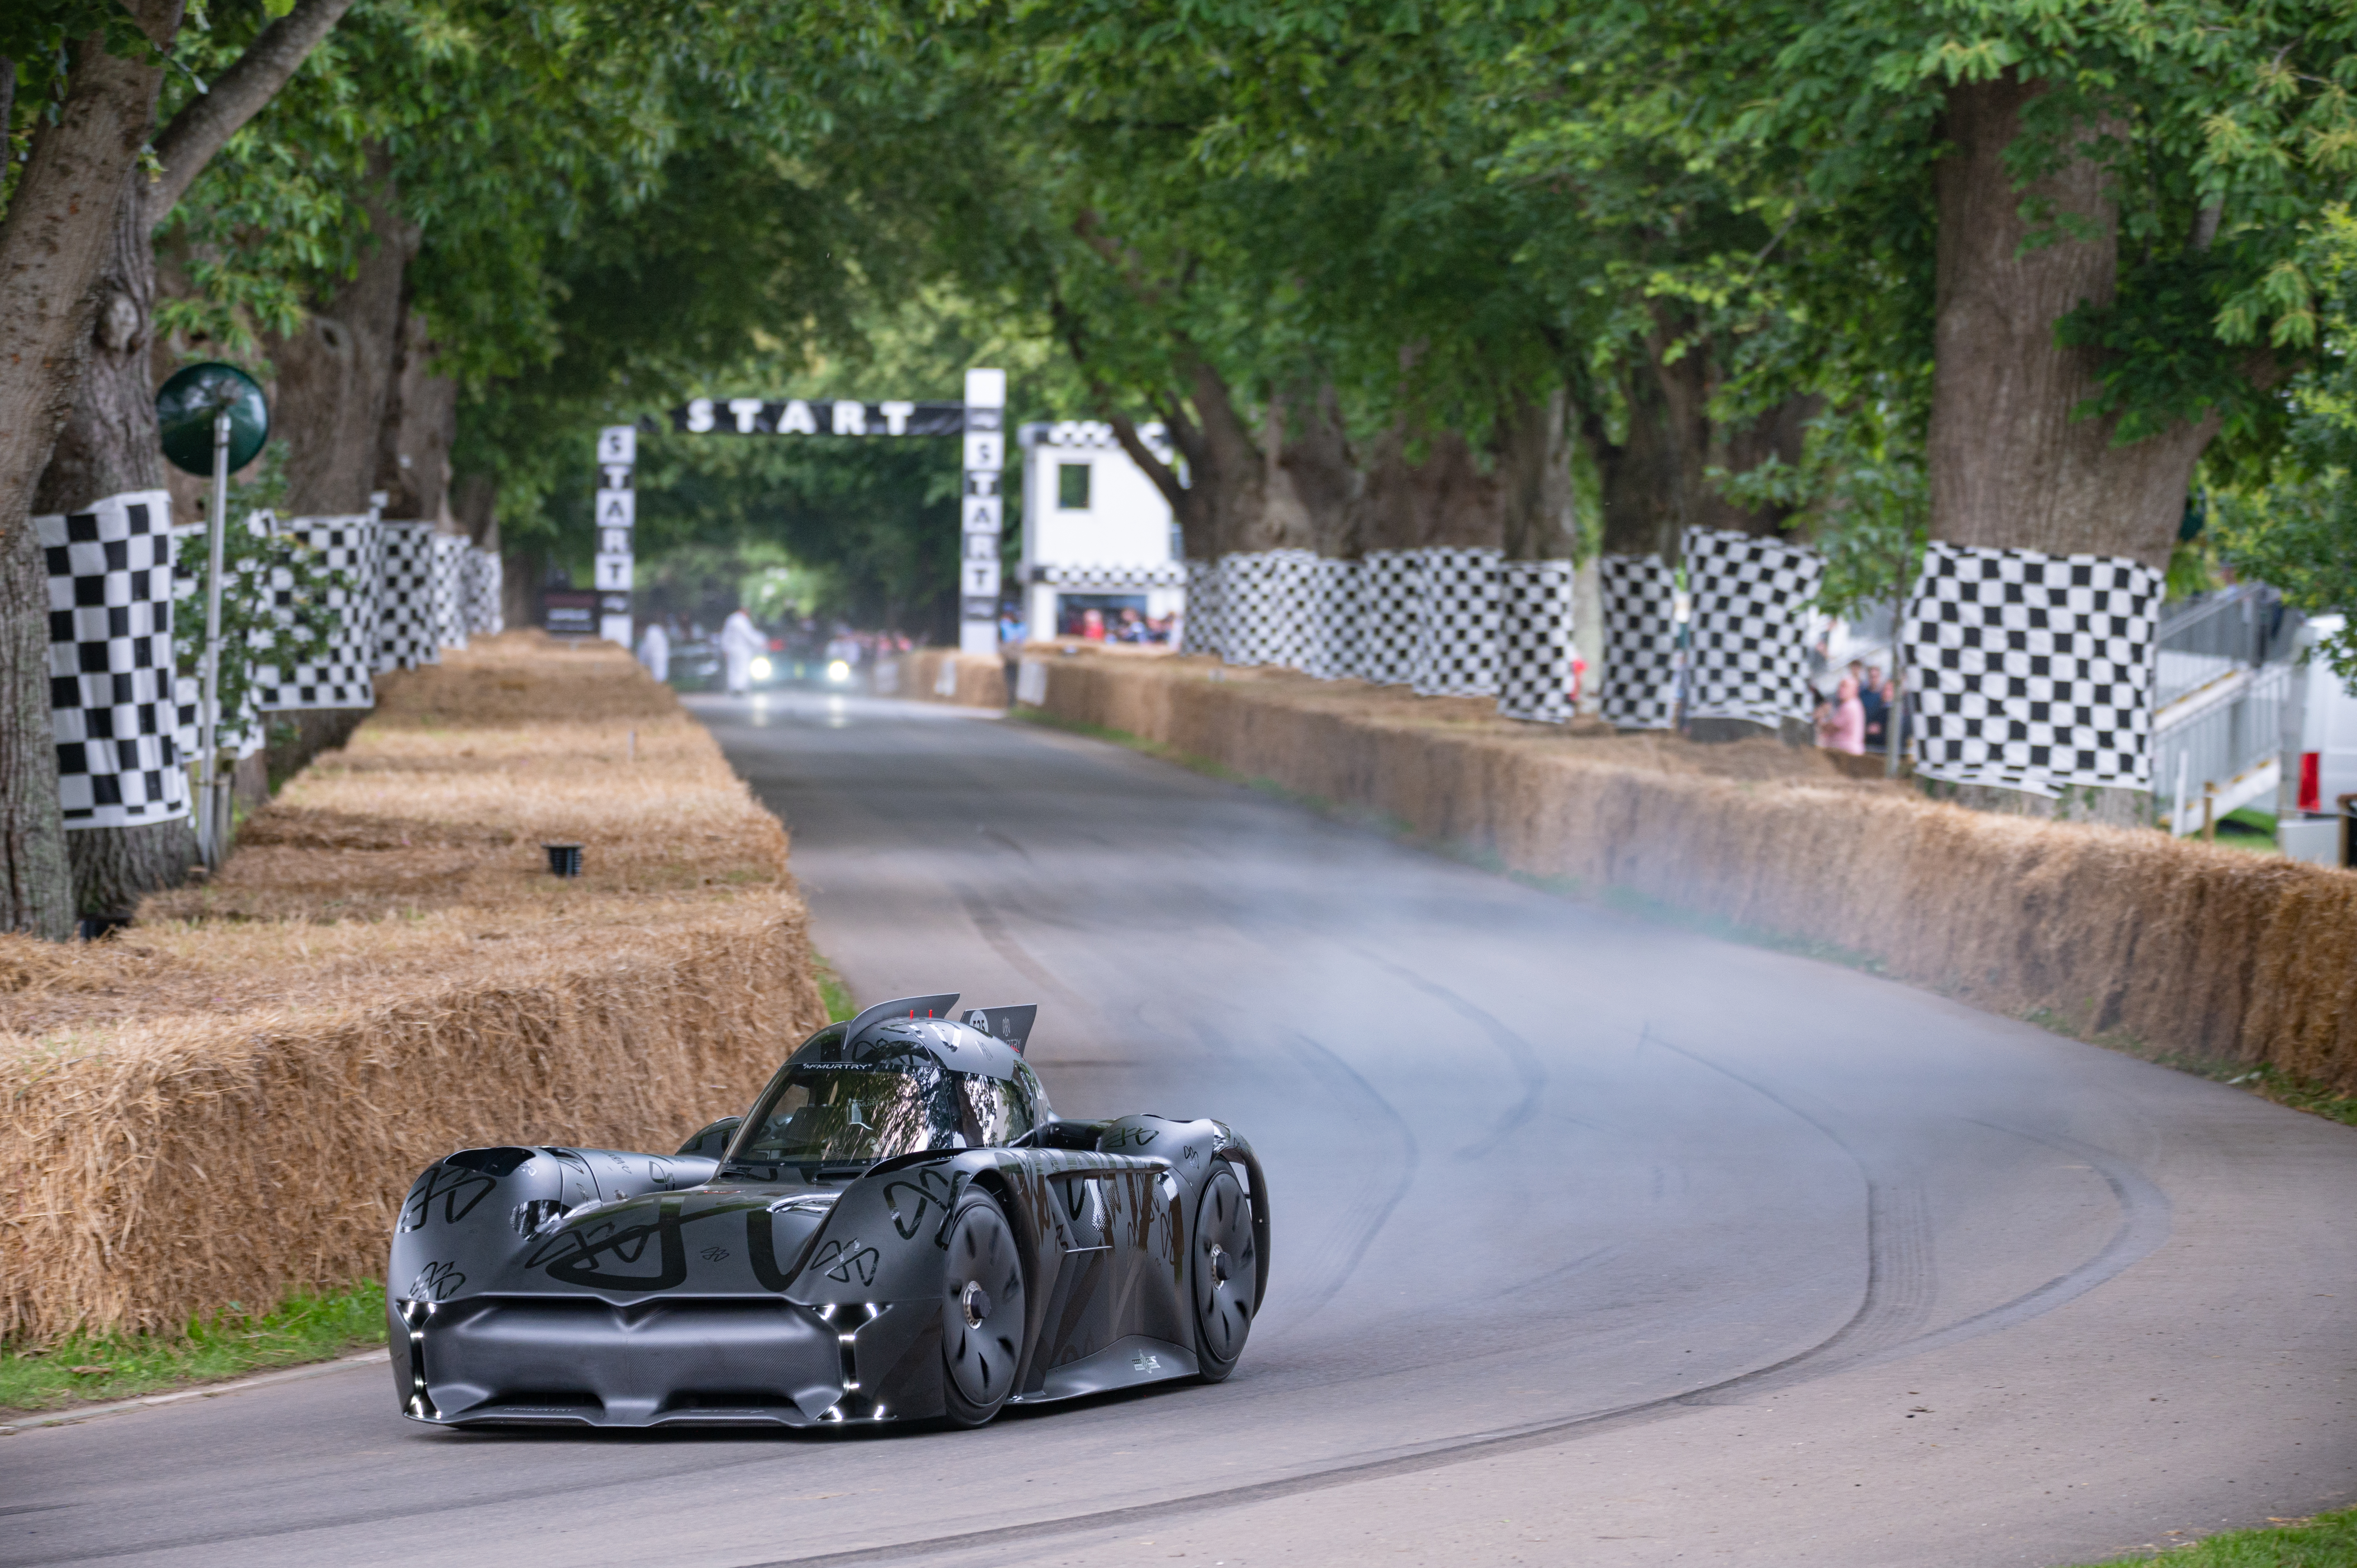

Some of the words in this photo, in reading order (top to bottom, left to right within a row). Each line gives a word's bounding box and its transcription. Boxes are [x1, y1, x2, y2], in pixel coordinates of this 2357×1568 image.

[687, 398, 915, 436] START
[603, 435, 631, 580] START
[969, 444, 997, 587] START
